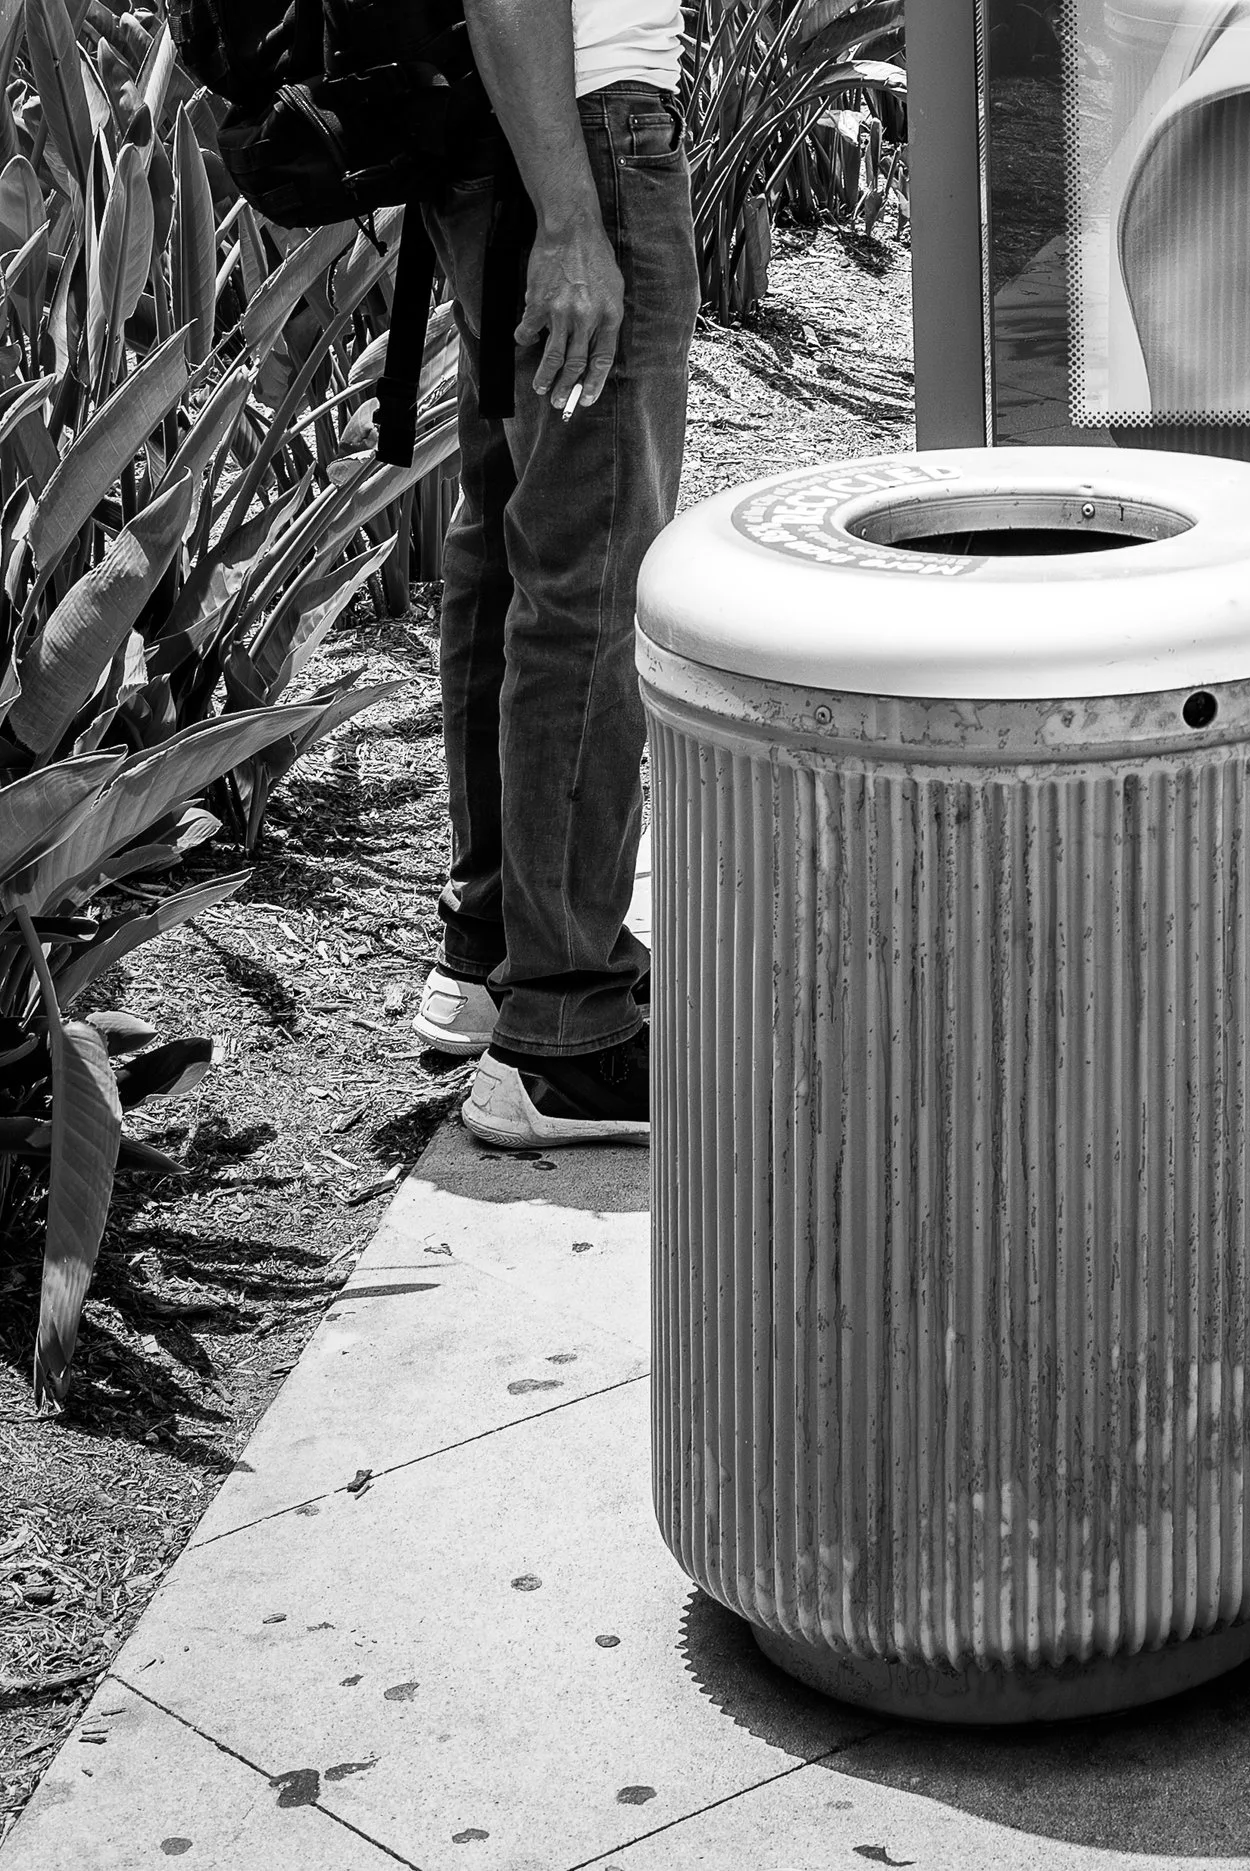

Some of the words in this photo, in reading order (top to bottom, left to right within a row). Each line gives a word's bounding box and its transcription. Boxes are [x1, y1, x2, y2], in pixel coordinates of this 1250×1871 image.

[771, 465, 963, 526] RECYCLED
[784, 541, 856, 563] than
[859, 559, 964, 576] More
